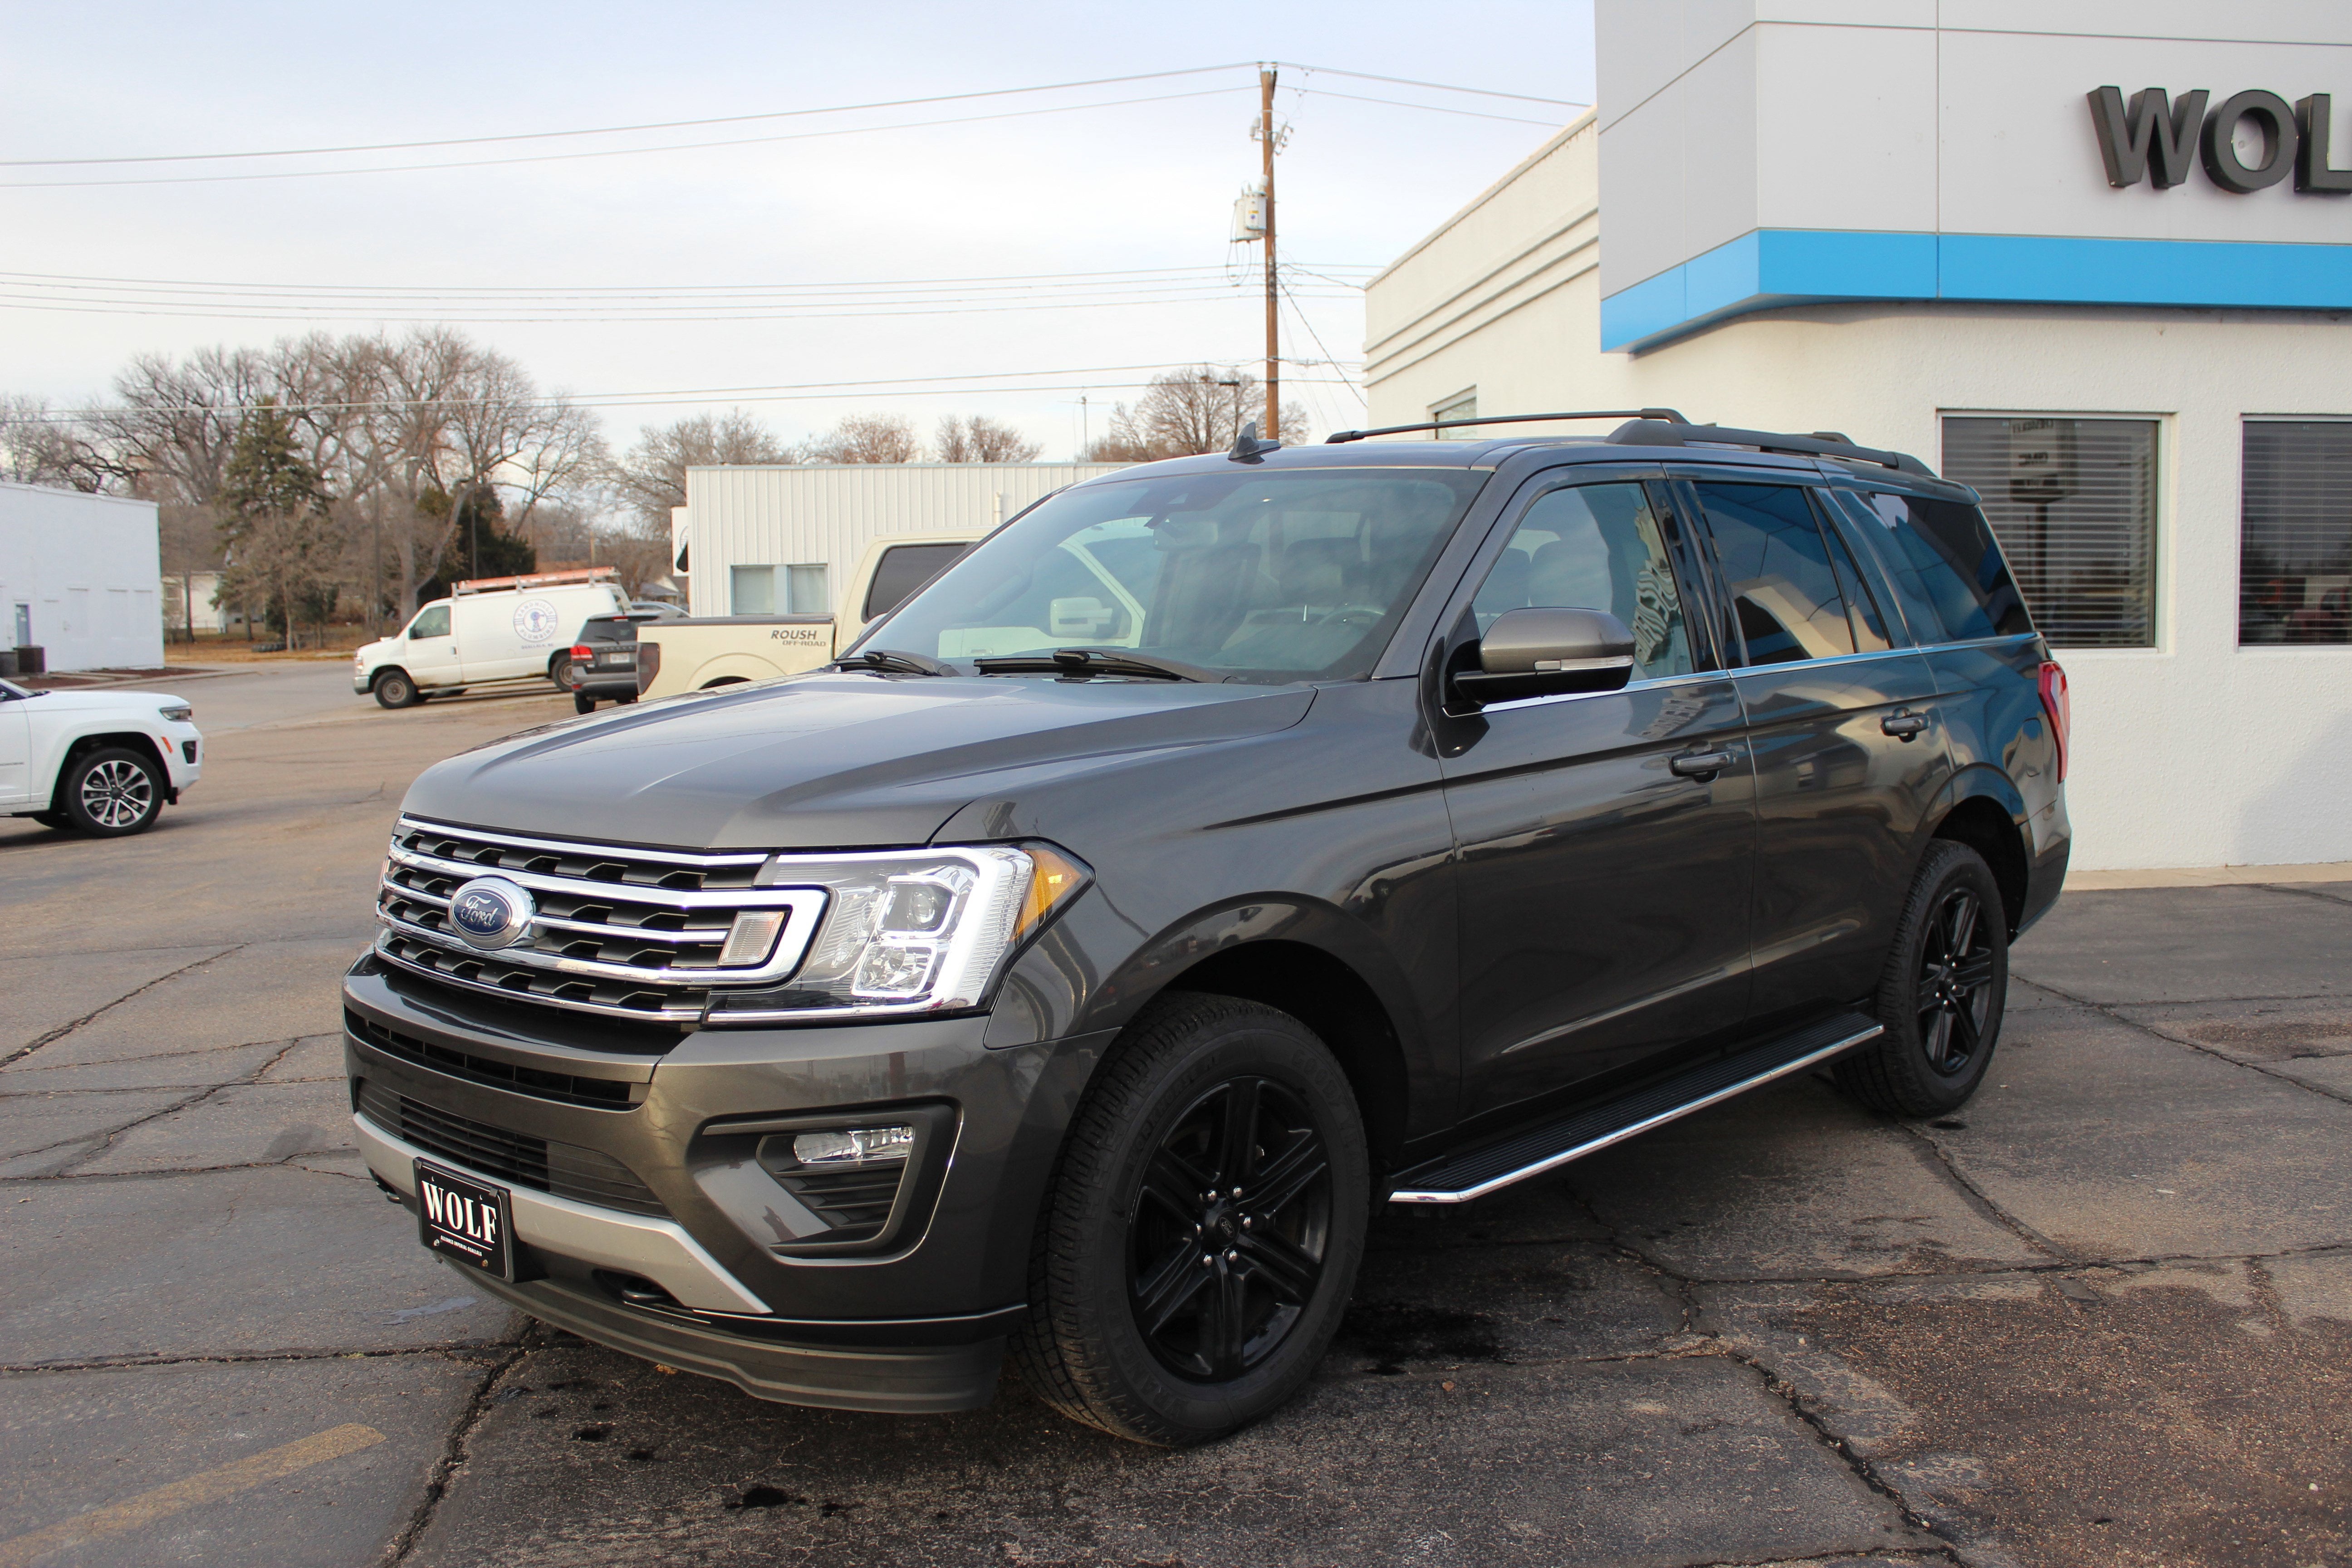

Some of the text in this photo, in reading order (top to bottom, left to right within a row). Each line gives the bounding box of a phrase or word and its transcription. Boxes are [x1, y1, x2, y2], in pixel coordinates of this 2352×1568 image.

[770, 630, 817, 640] ROUSH
[461, 895, 499, 926] Ford
[421, 1180, 497, 1244] WOLF
[1221, 1220, 1233, 1235] Ford
